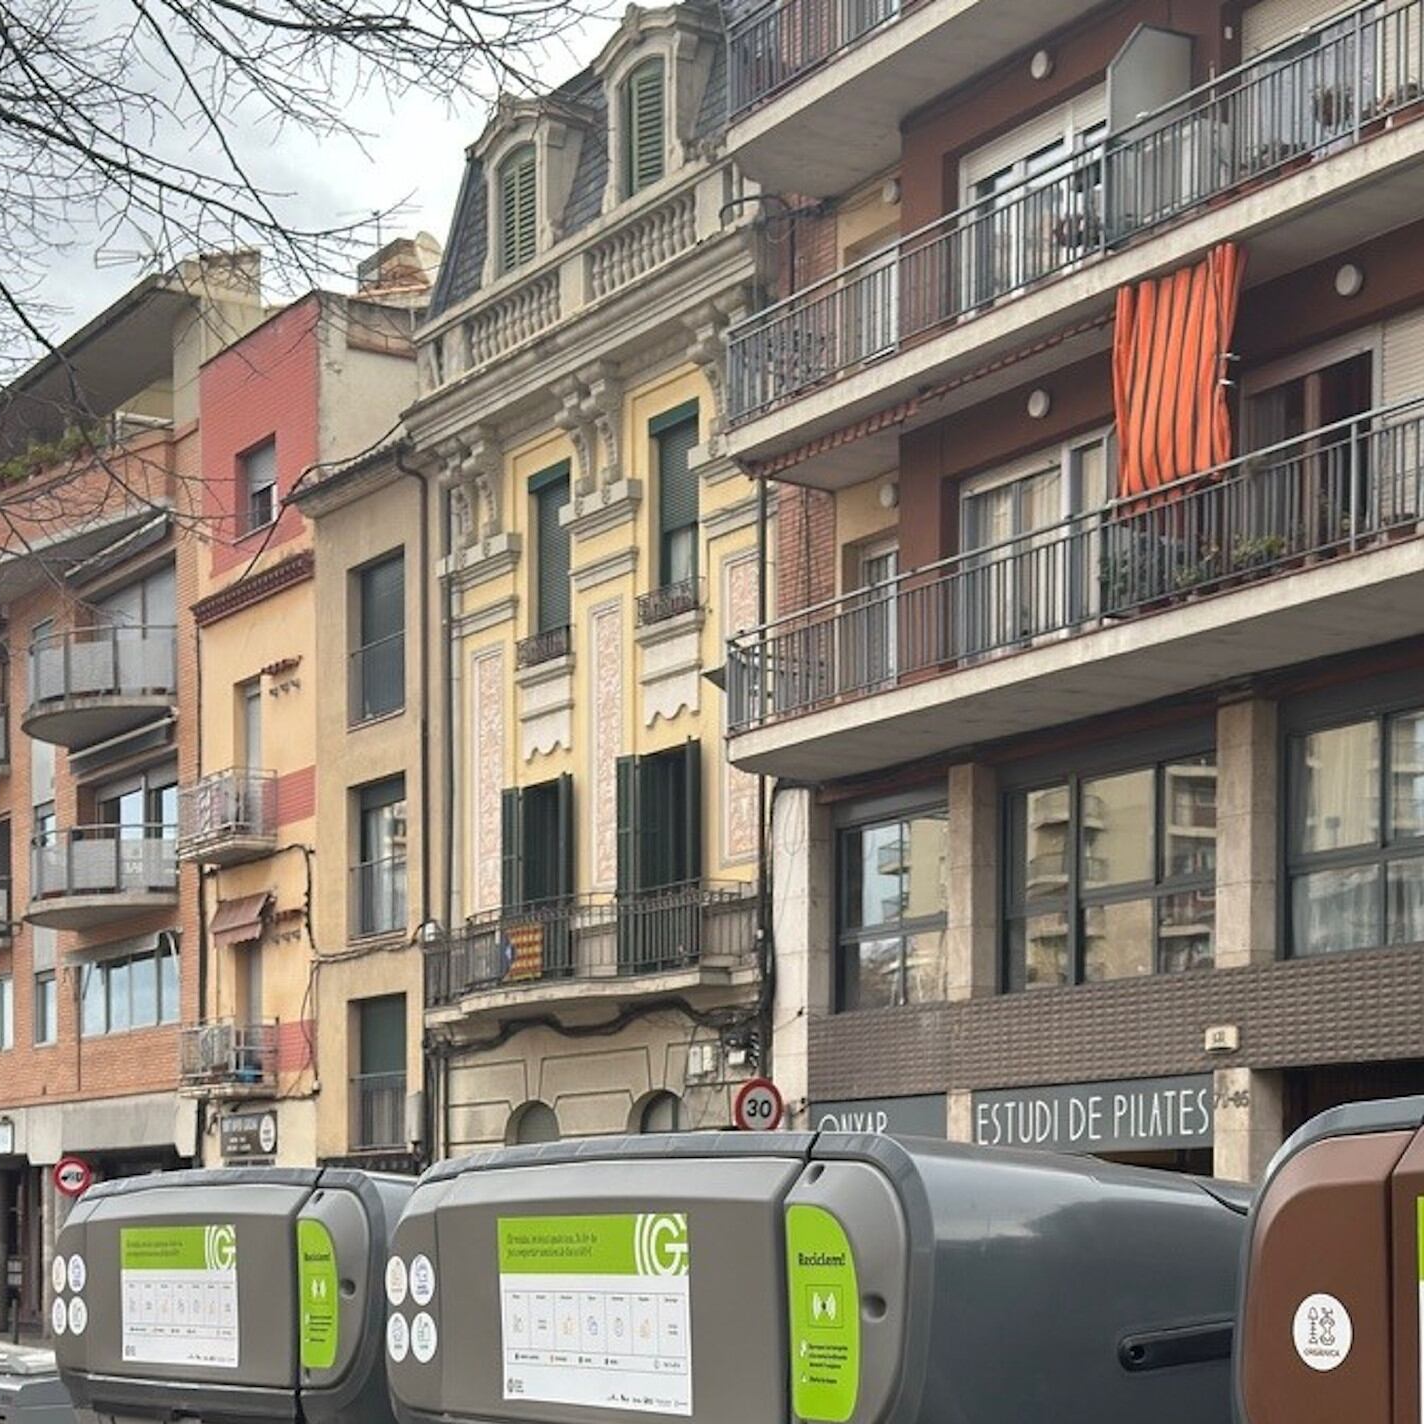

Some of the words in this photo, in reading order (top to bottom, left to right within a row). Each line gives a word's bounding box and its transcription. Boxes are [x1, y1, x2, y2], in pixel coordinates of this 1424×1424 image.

[747, 1099, 772, 1118] 30
[976, 1100, 1058, 1145] ESTUDI
[1069, 1096, 1102, 1141] DE
[1114, 1088, 1208, 1138] PILATES
